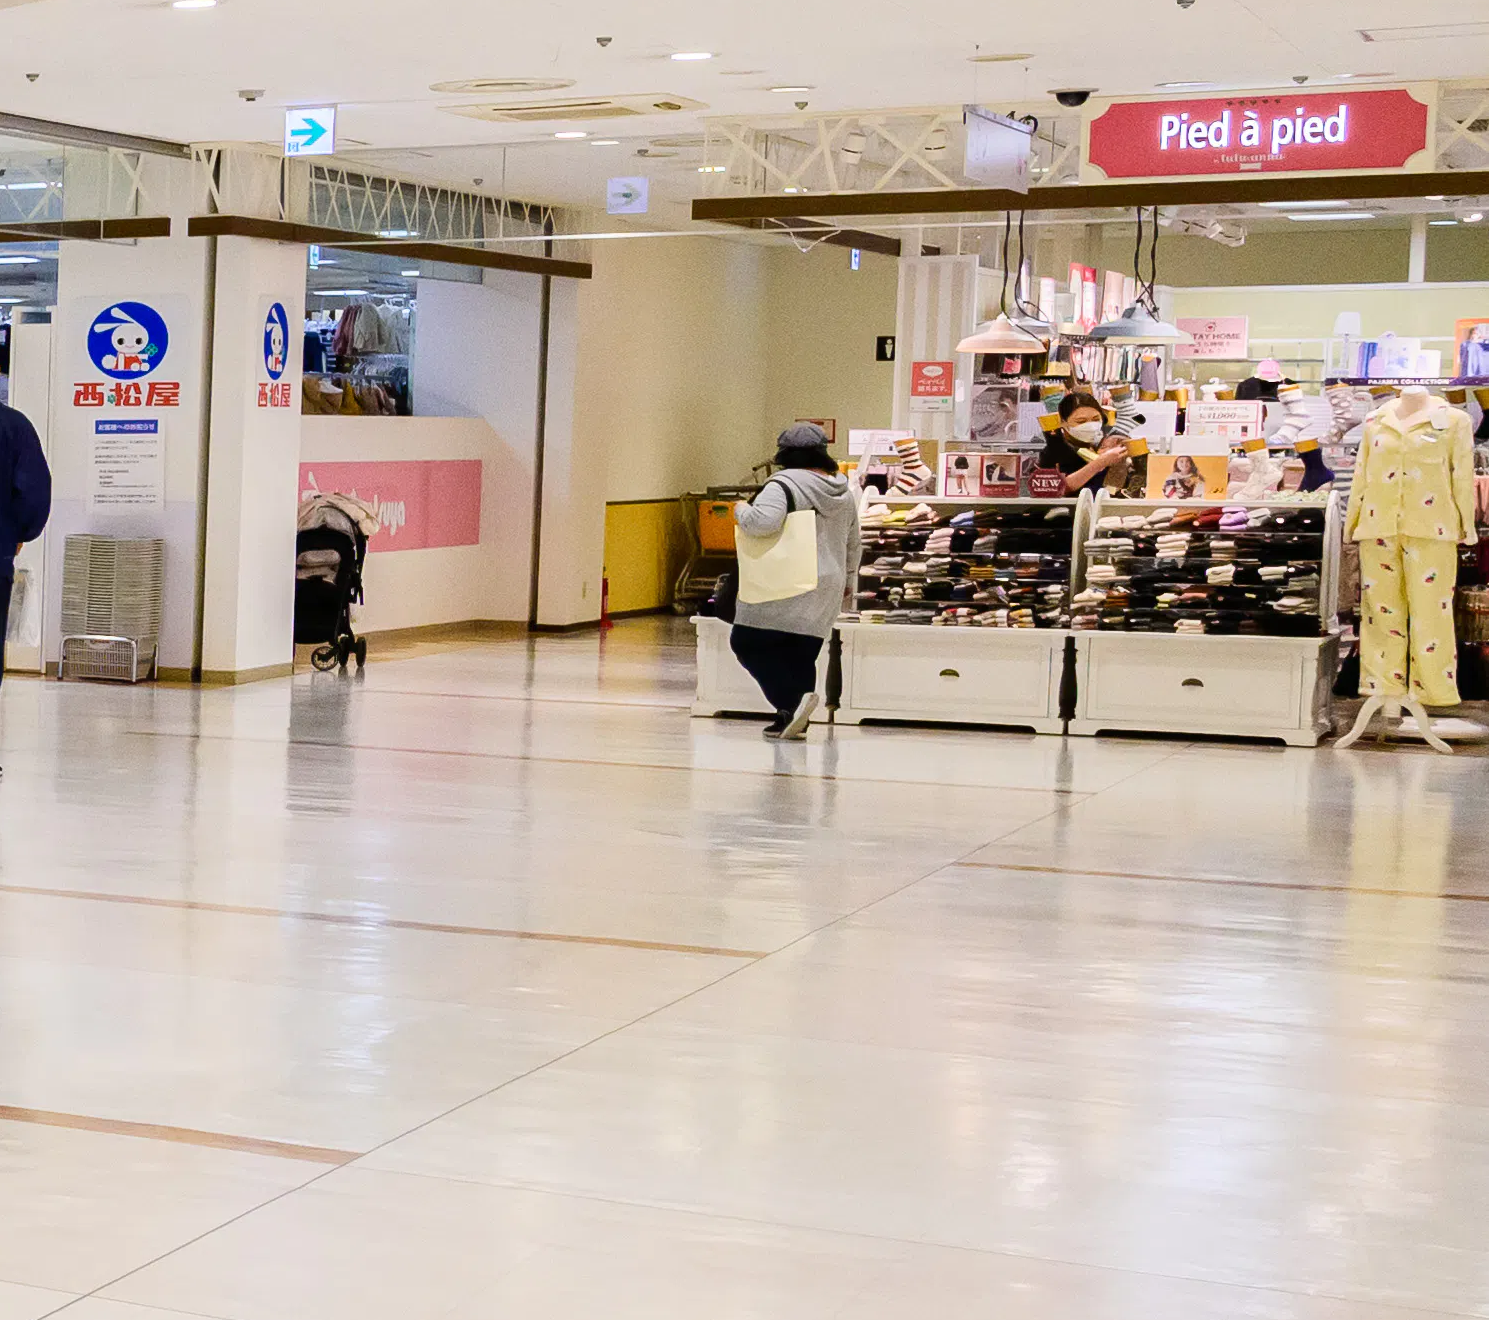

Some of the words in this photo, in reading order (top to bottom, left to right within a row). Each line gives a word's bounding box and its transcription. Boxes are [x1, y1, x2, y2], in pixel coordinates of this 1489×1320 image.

[1160, 109, 1231, 151] Pied
[1240, 110, 1260, 147] à
[1271, 104, 1348, 156] pied
[73, 382, 180, 407] 西松屋
[257, 382, 291, 408] 西松屋
[1031, 479, 1062, 487] NEW
